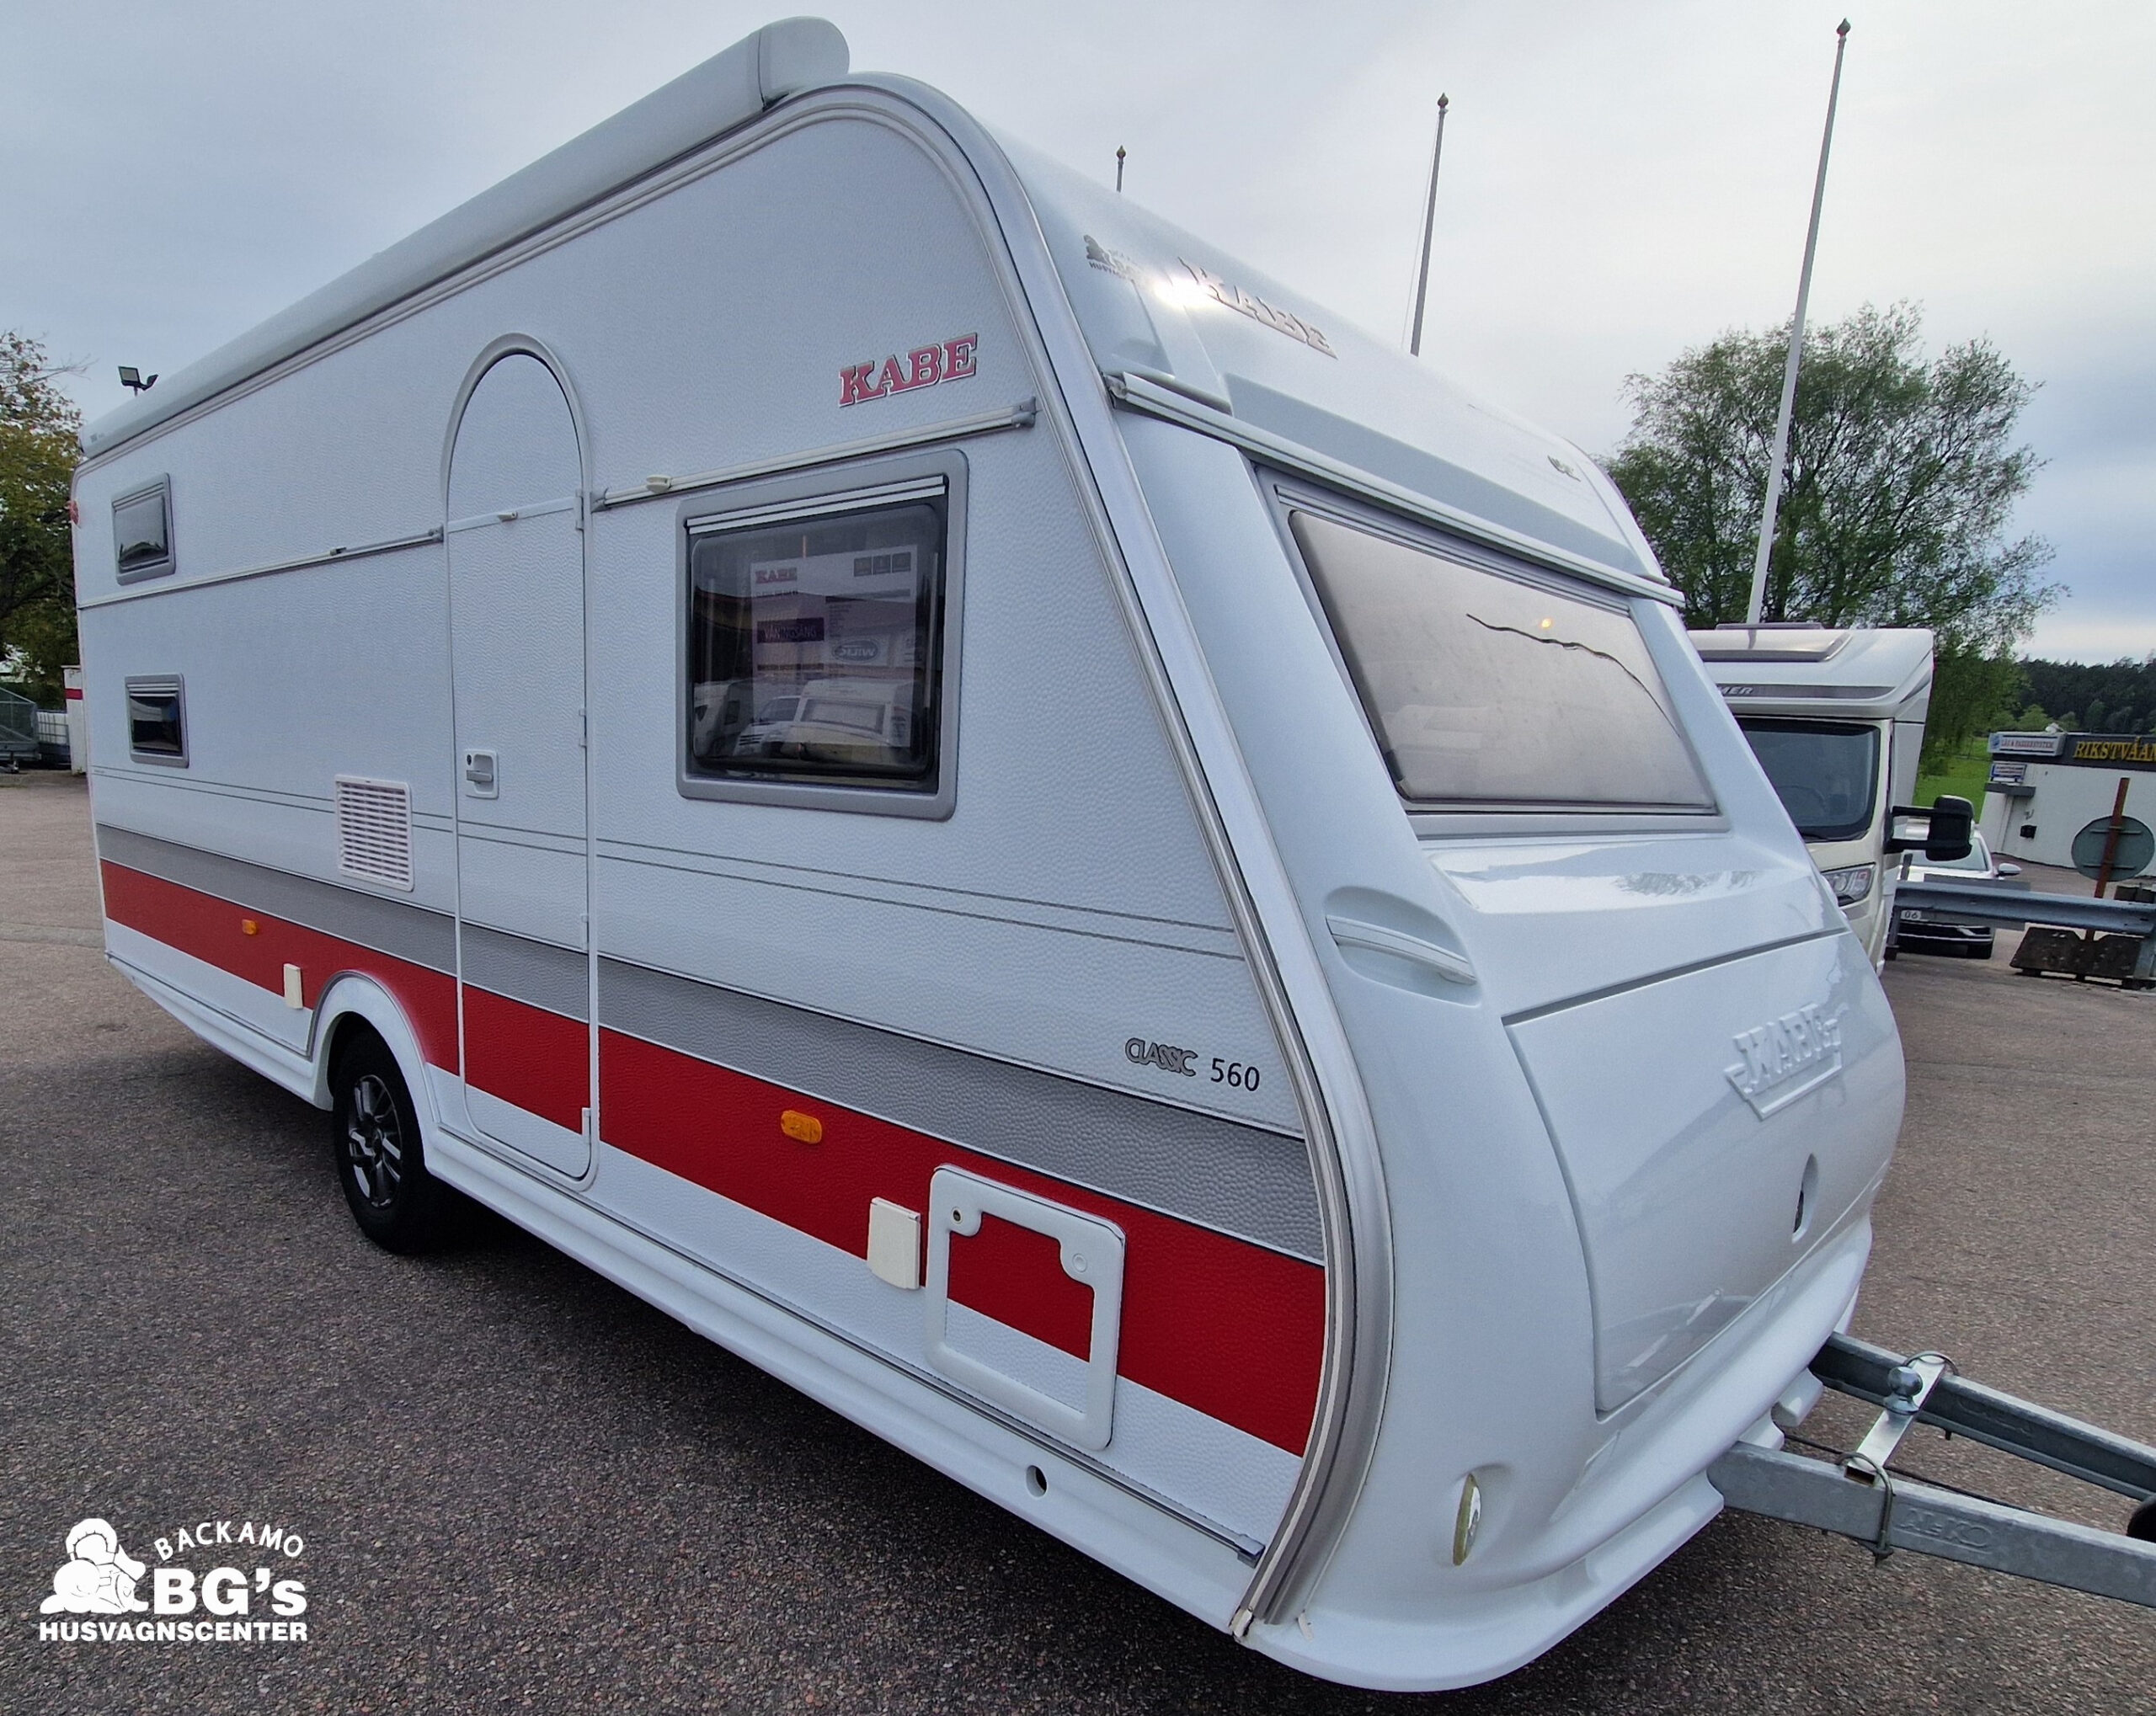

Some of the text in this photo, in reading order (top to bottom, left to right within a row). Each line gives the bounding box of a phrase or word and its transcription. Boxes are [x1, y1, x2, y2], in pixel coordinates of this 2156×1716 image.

[1177, 255, 1339, 360] KABE
[839, 332, 978, 408] KABE
[1125, 1037, 1260, 1091] CLASSIC 560
[1726, 1003, 1842, 1097] KABE
